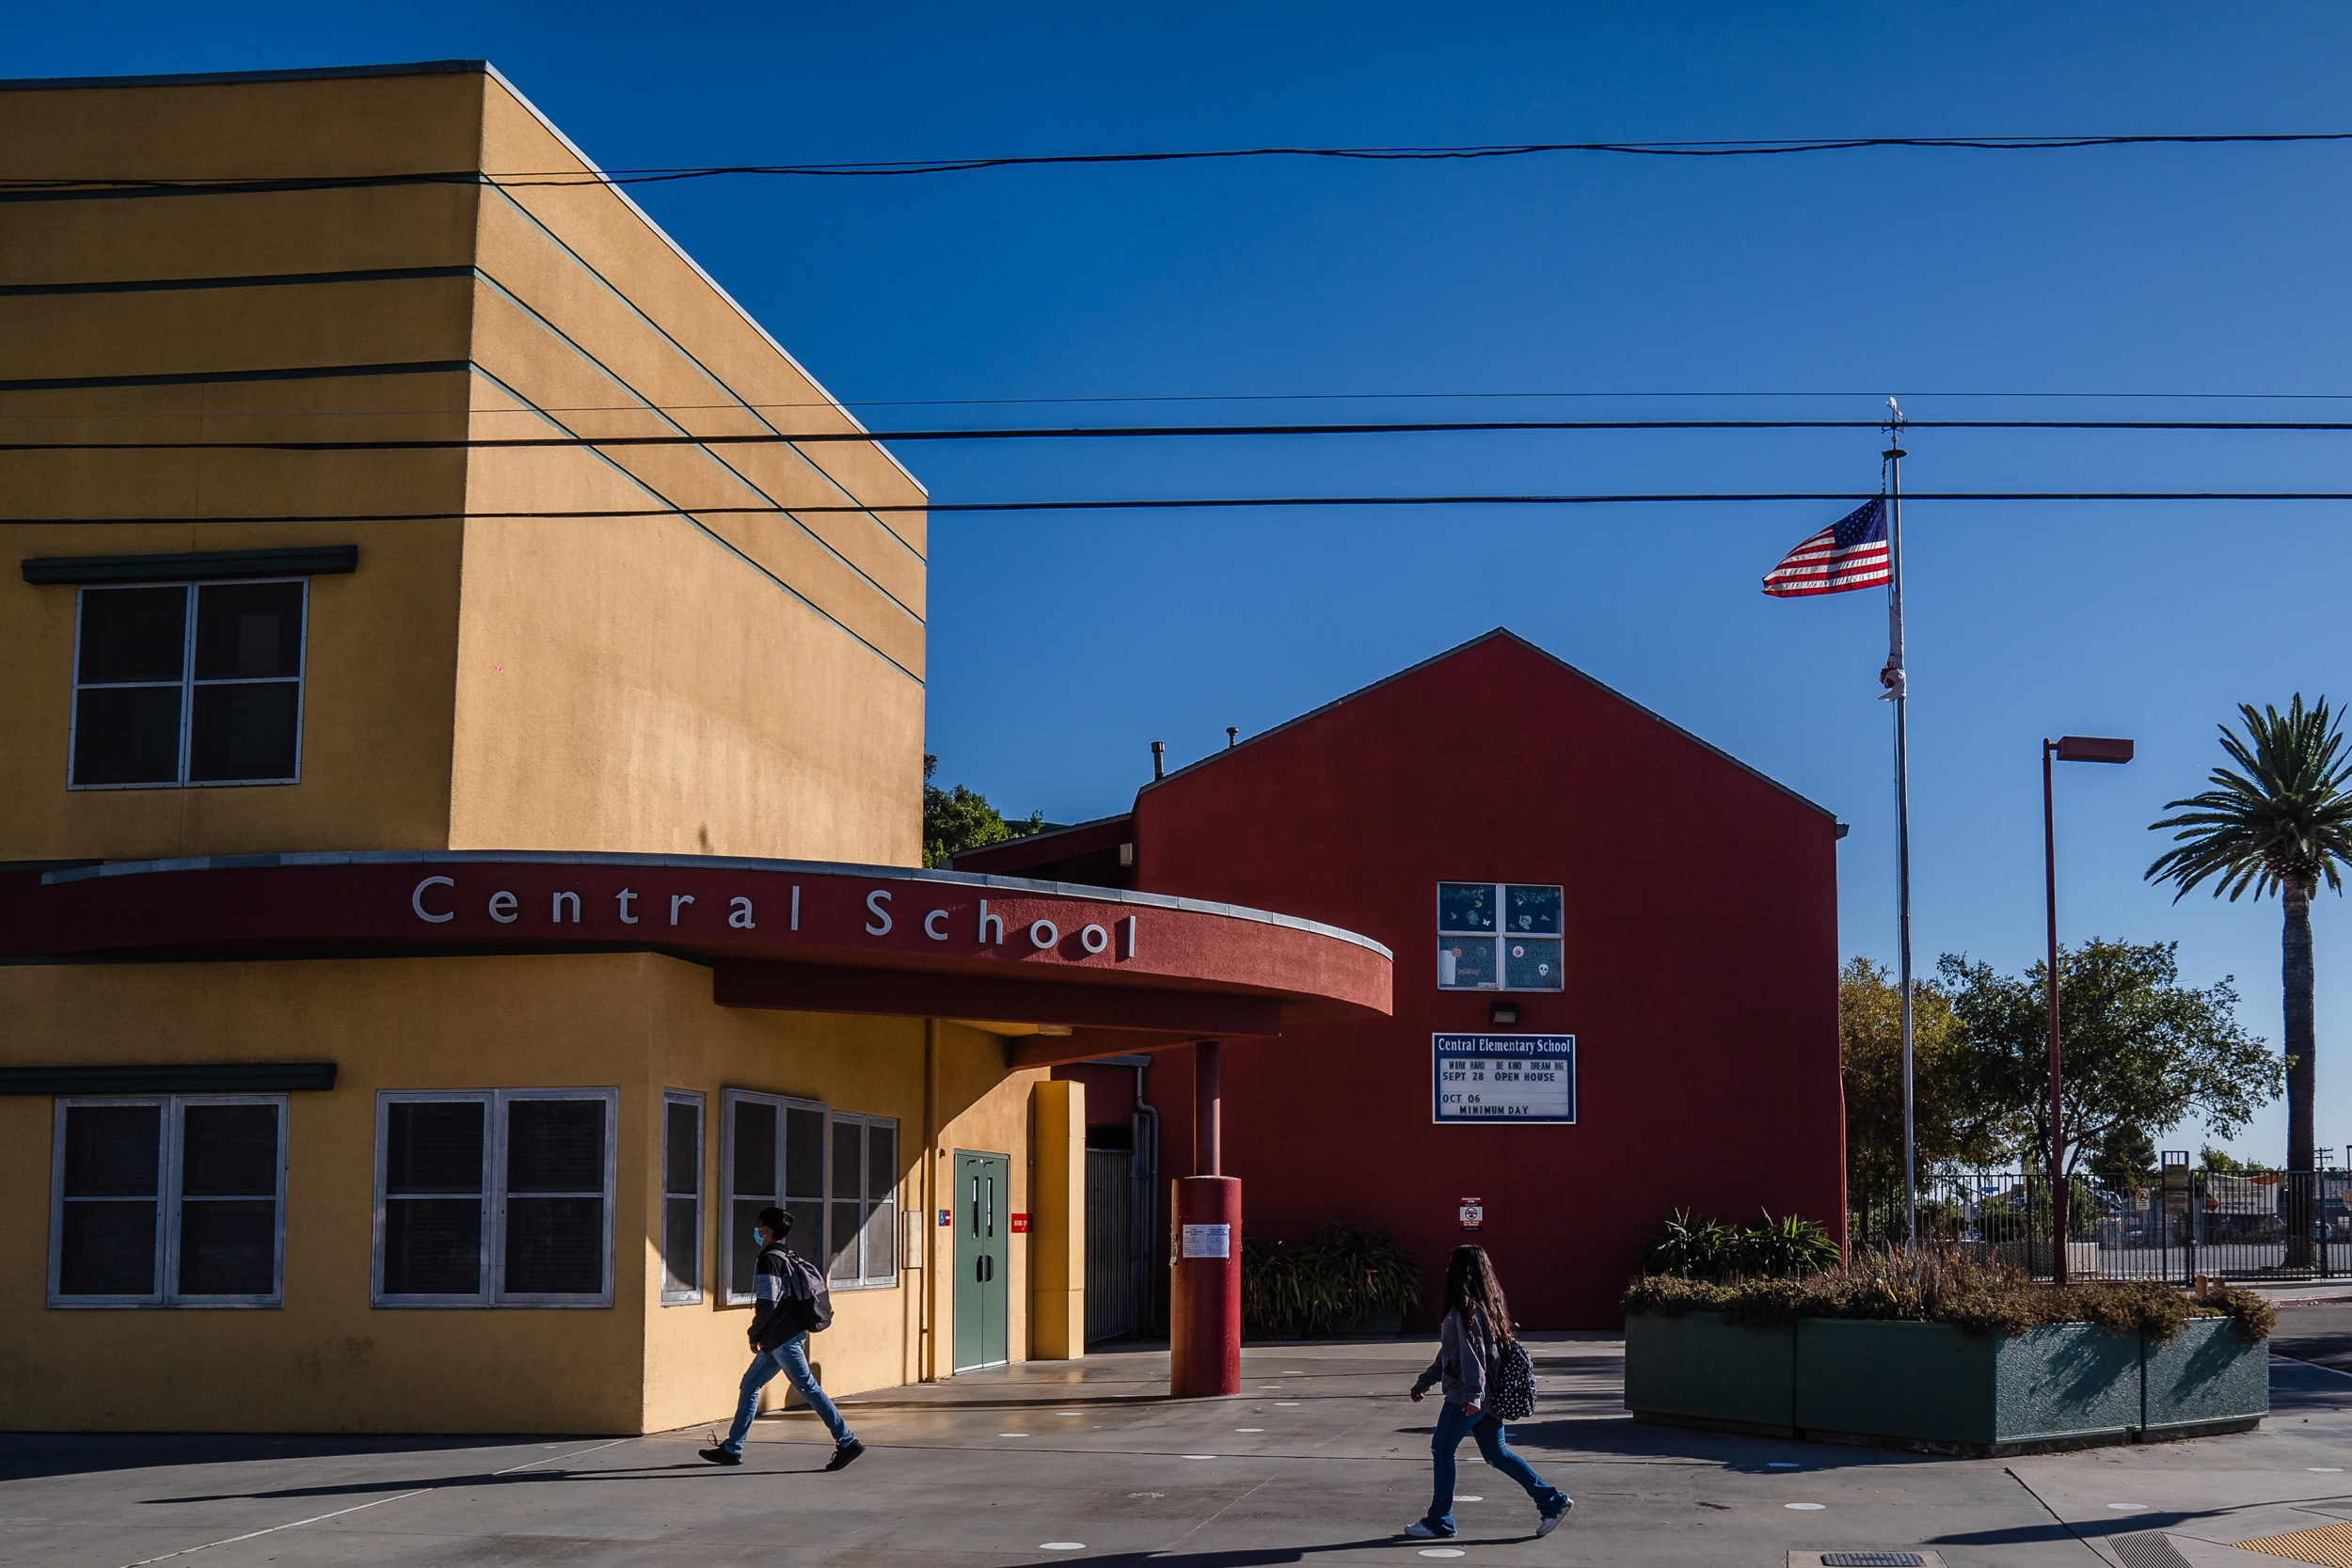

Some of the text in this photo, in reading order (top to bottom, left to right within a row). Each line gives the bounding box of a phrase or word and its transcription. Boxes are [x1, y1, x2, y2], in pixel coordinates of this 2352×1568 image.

[411, 876, 1136, 958] Central School
[1438, 1037, 1570, 1054] Central Elementary School
[1449, 1061, 1564, 1070] WORK HARD BE KIND DREAM BIG
[1442, 1072, 1555, 1082] SEPT 28 OPEN HOUSE
[1442, 1094, 1480, 1103] OCT 06
[1460, 1106, 1528, 1115] MINIMUM DAY
